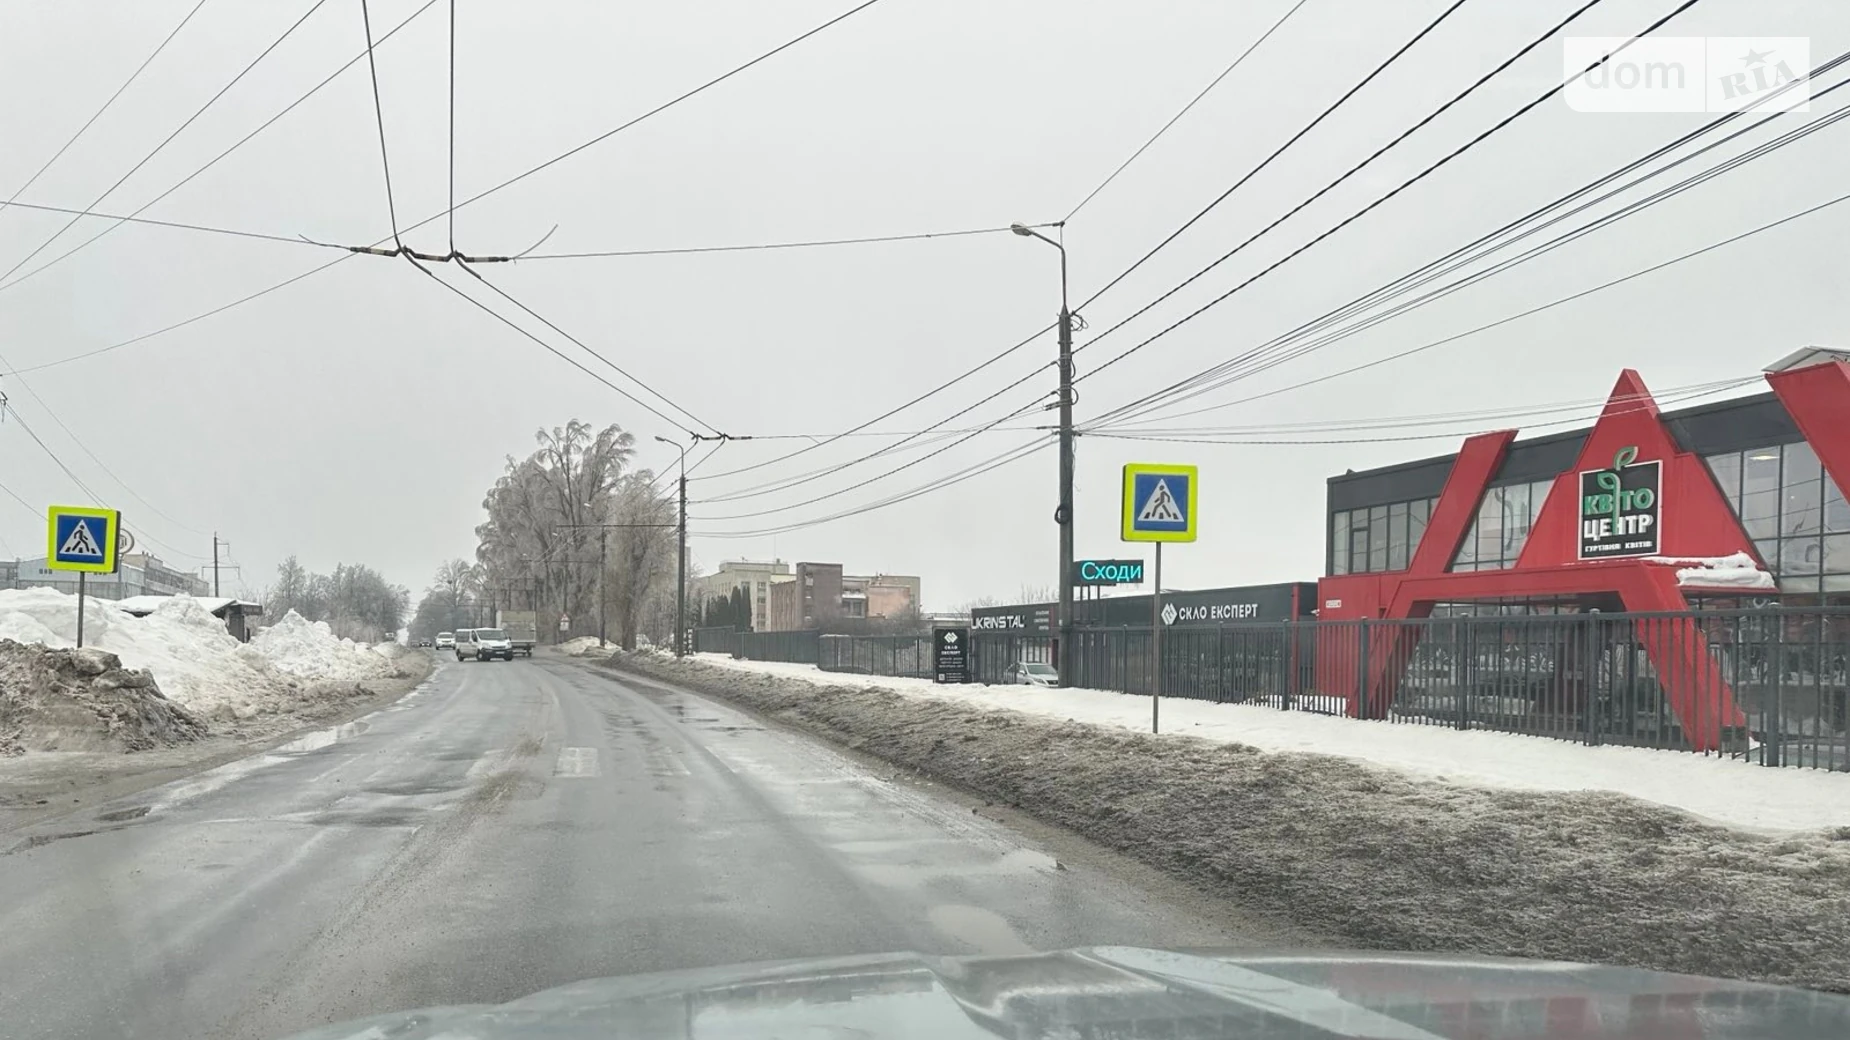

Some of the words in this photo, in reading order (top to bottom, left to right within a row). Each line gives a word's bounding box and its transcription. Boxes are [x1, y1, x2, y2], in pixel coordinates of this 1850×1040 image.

[1584, 514, 1654, 541] ЦЕНТР
[1081, 561, 1141, 582] Сходи
[1178, 605, 1208, 620] СКЛО
[1211, 603, 1258, 620] ЕКСПЕРТ
